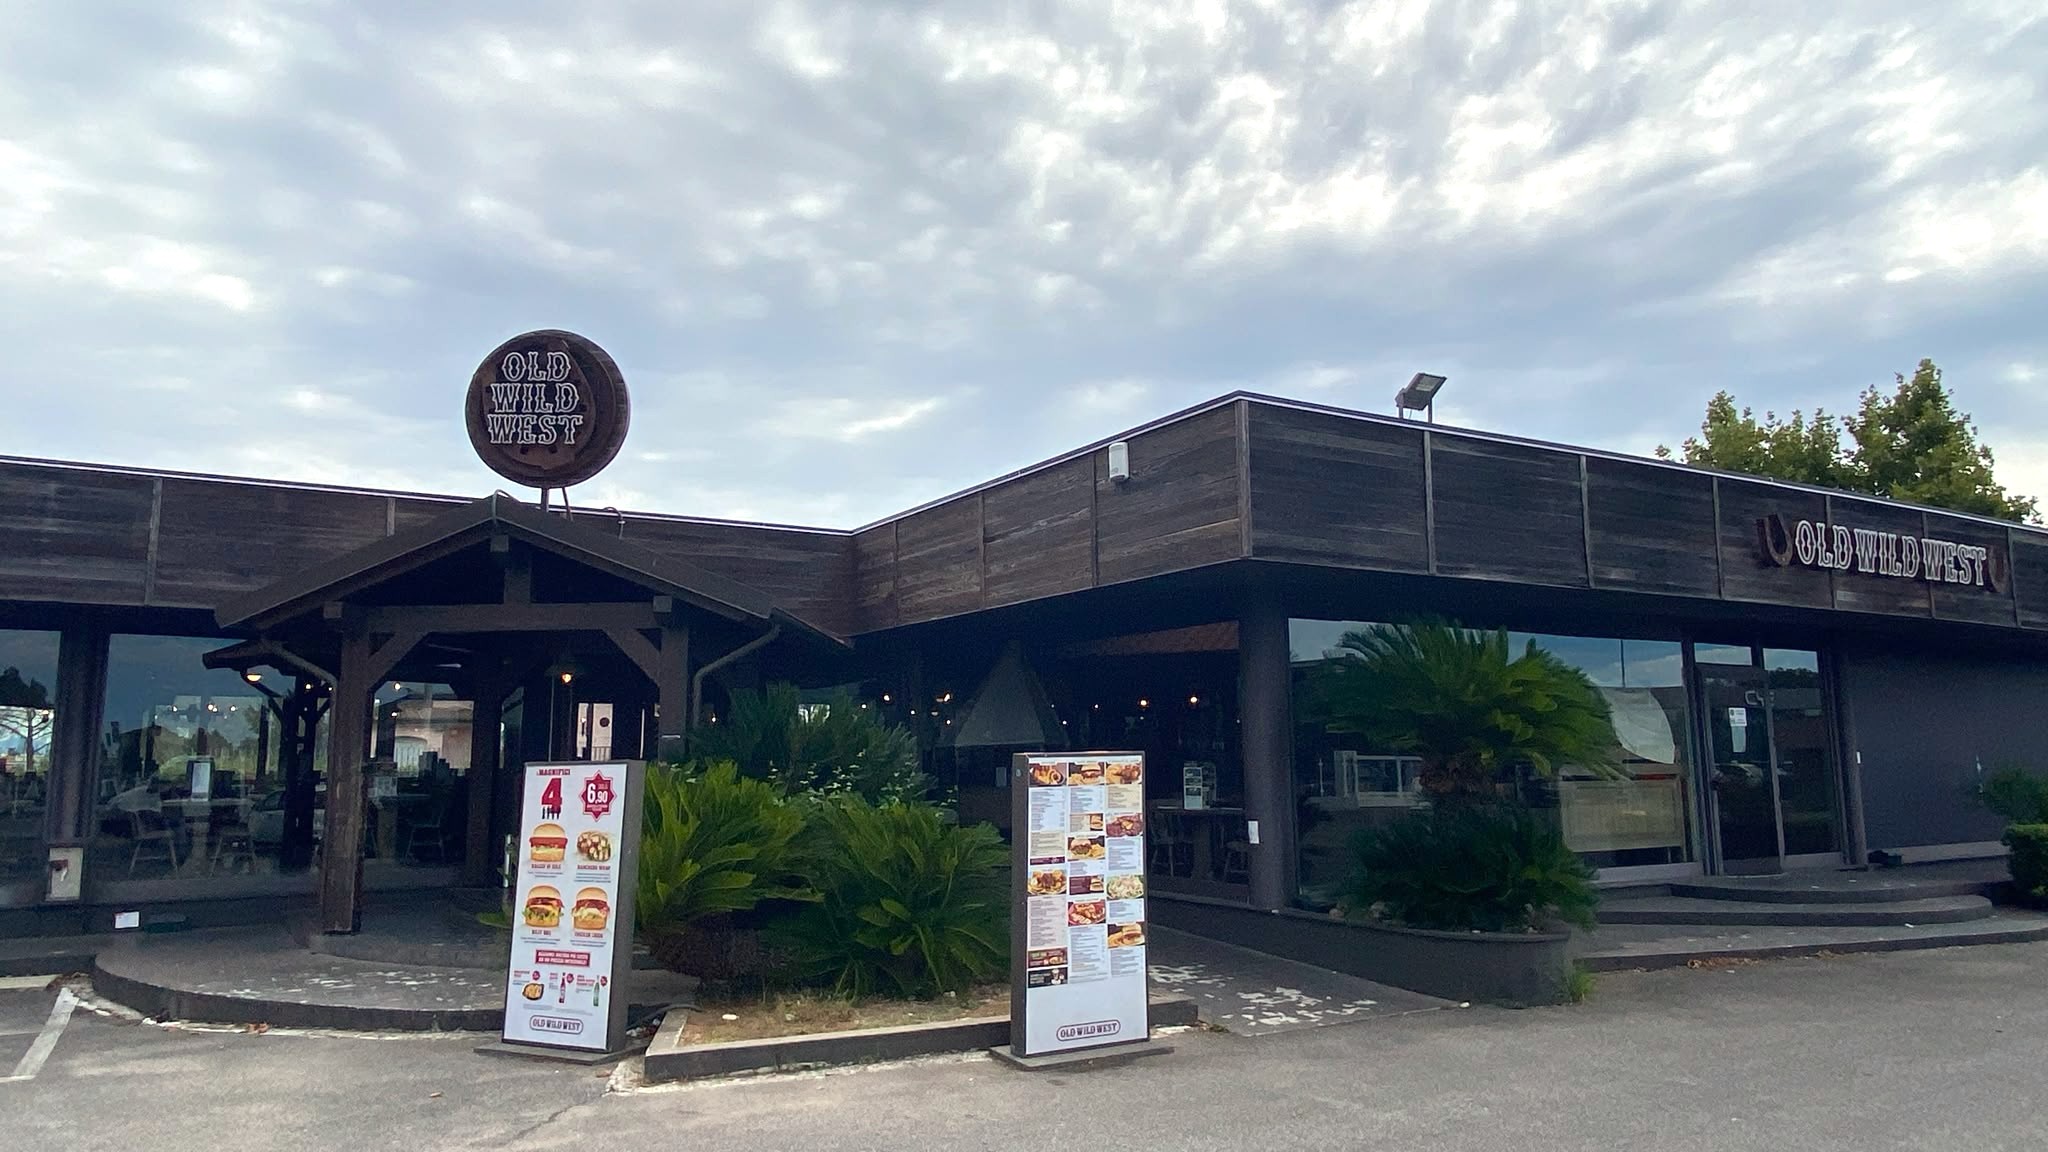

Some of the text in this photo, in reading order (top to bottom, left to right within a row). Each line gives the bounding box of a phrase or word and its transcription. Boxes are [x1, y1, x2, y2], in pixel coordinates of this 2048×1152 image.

[502, 351, 571, 381] OLD
[490, 382, 580, 413] WILD
[487, 414, 583, 445] WEST
[1795, 519, 1987, 586] OLD WILD WEST
[541, 778, 562, 815] 4
[532, 1018, 581, 1031] OLD WILD WEST
[1060, 1022, 1117, 1038] OLD WILD WEST
